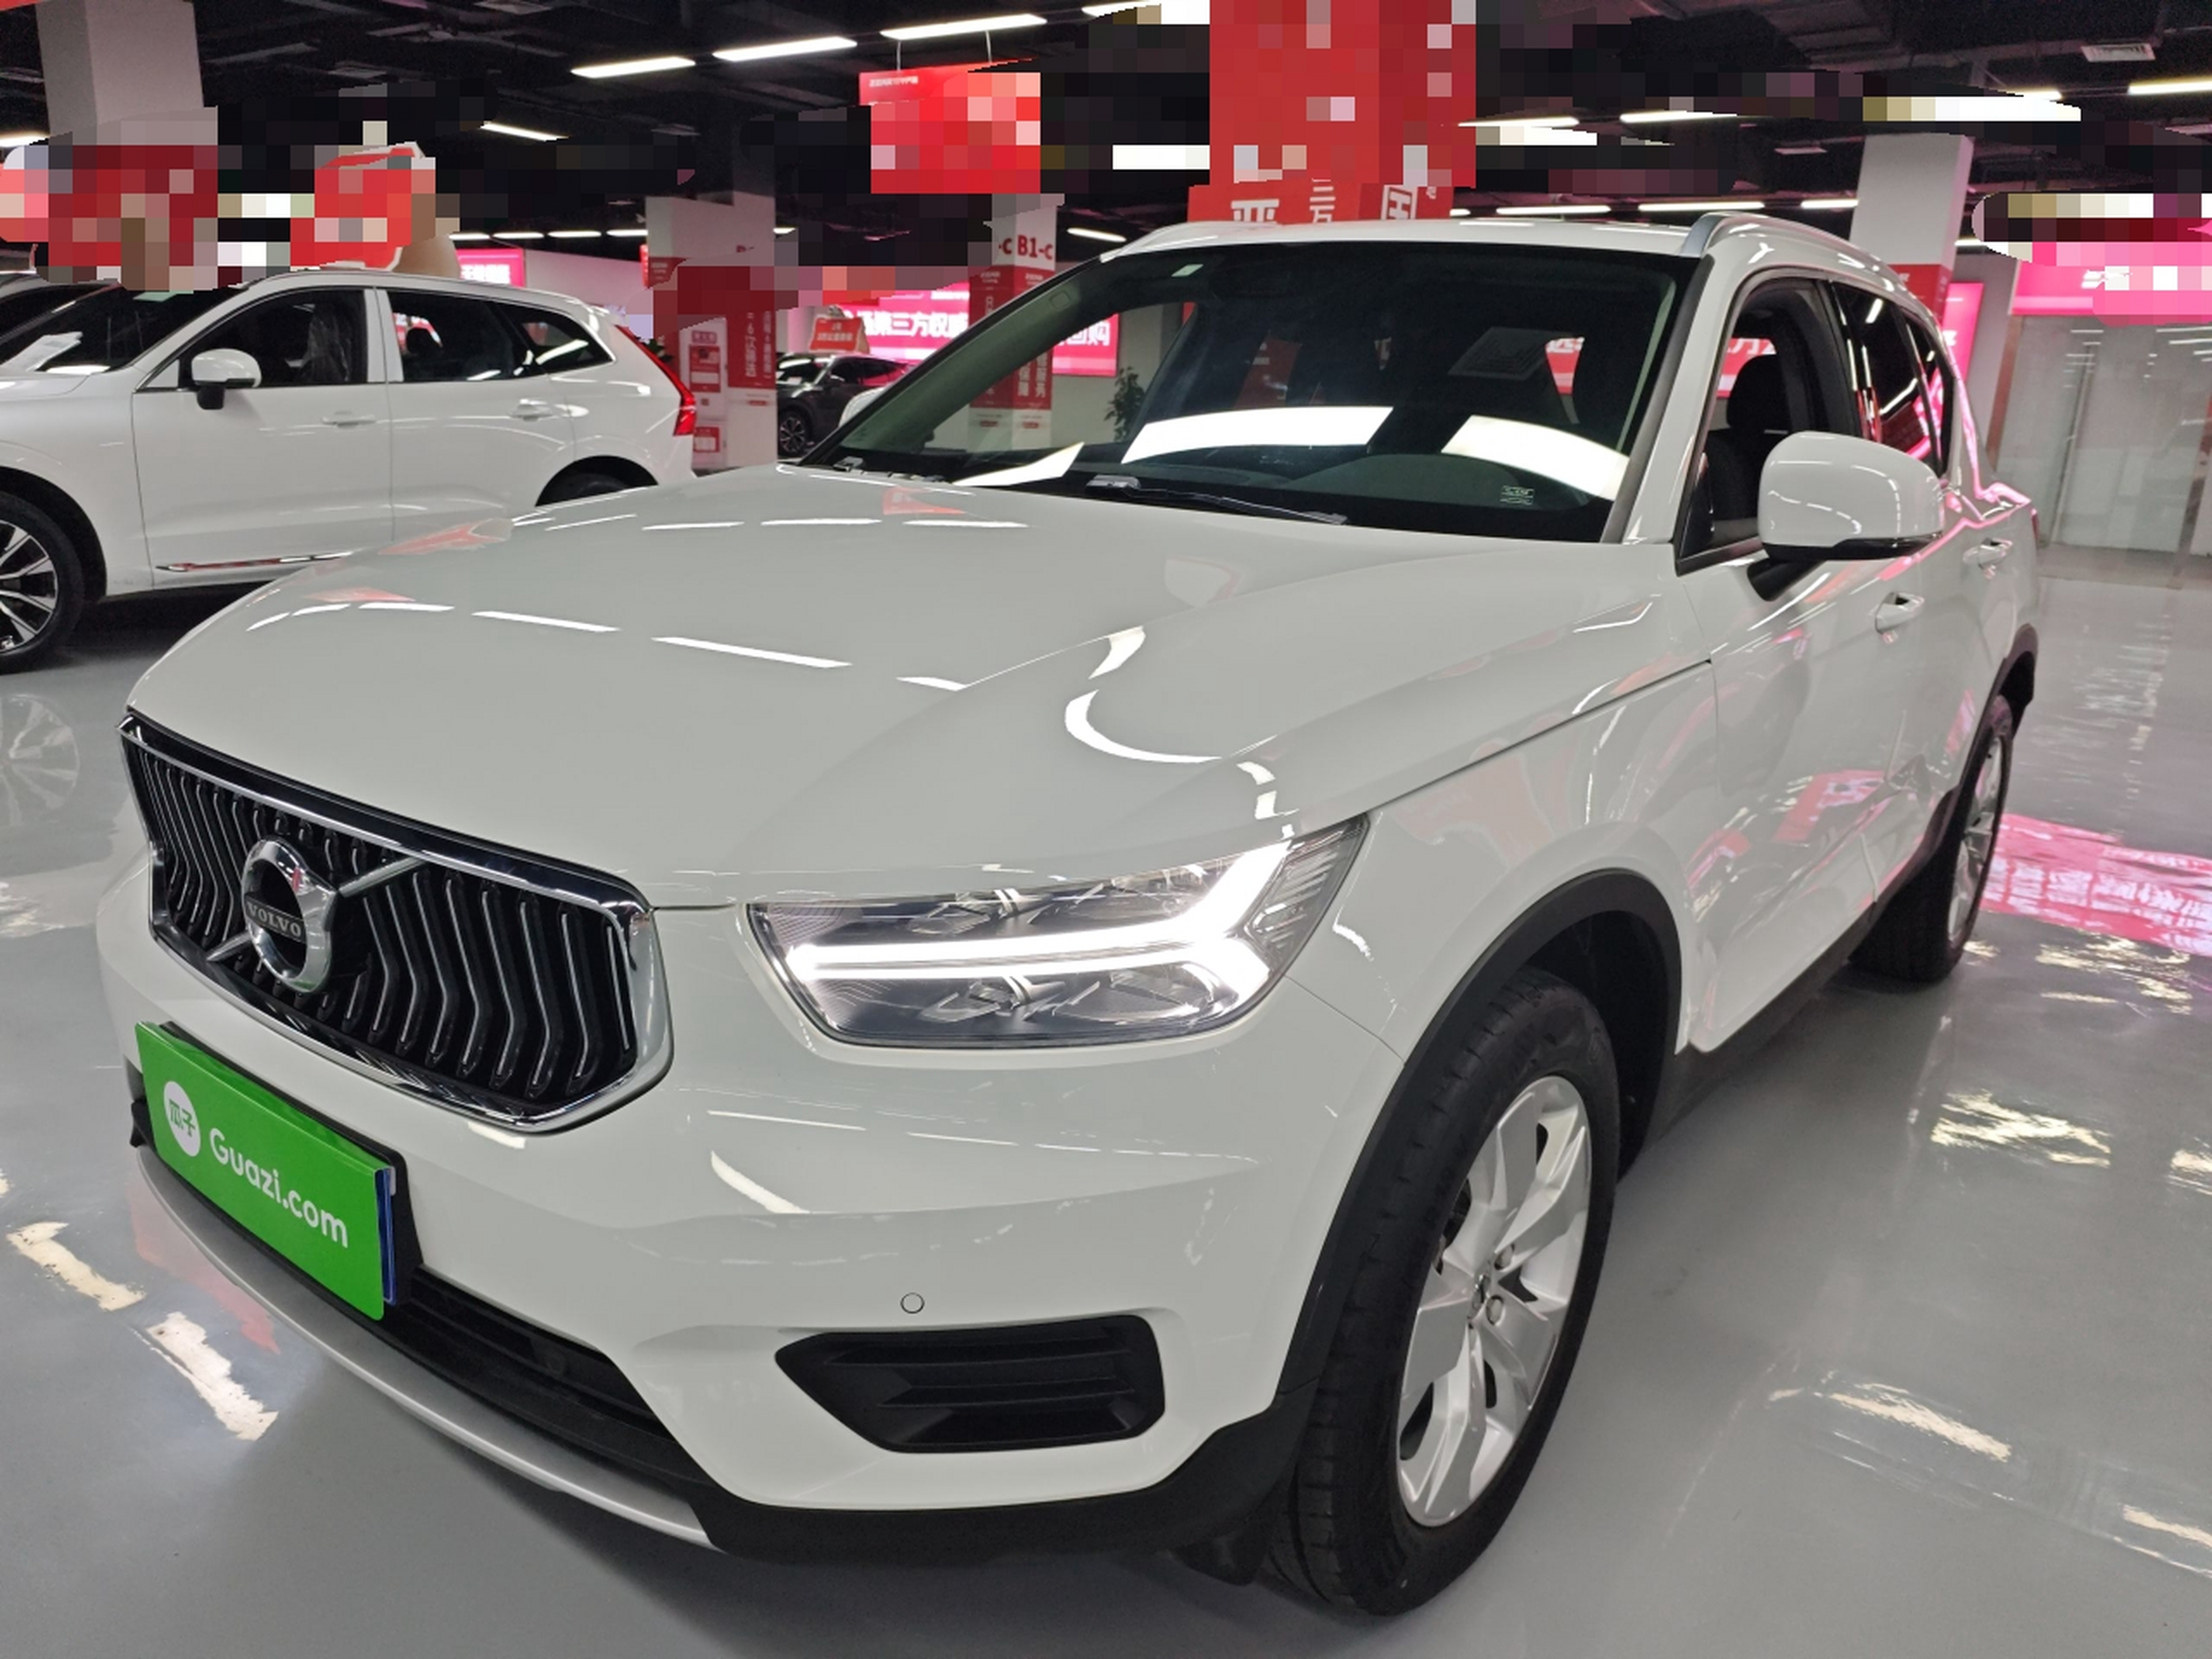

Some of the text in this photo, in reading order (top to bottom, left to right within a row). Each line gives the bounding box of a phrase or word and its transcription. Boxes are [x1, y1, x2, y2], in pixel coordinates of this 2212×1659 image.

[247, 901, 301, 937] VOLVO
[169, 1098, 195, 1137] 瓜子
[210, 1128, 348, 1248] Guazi.com
